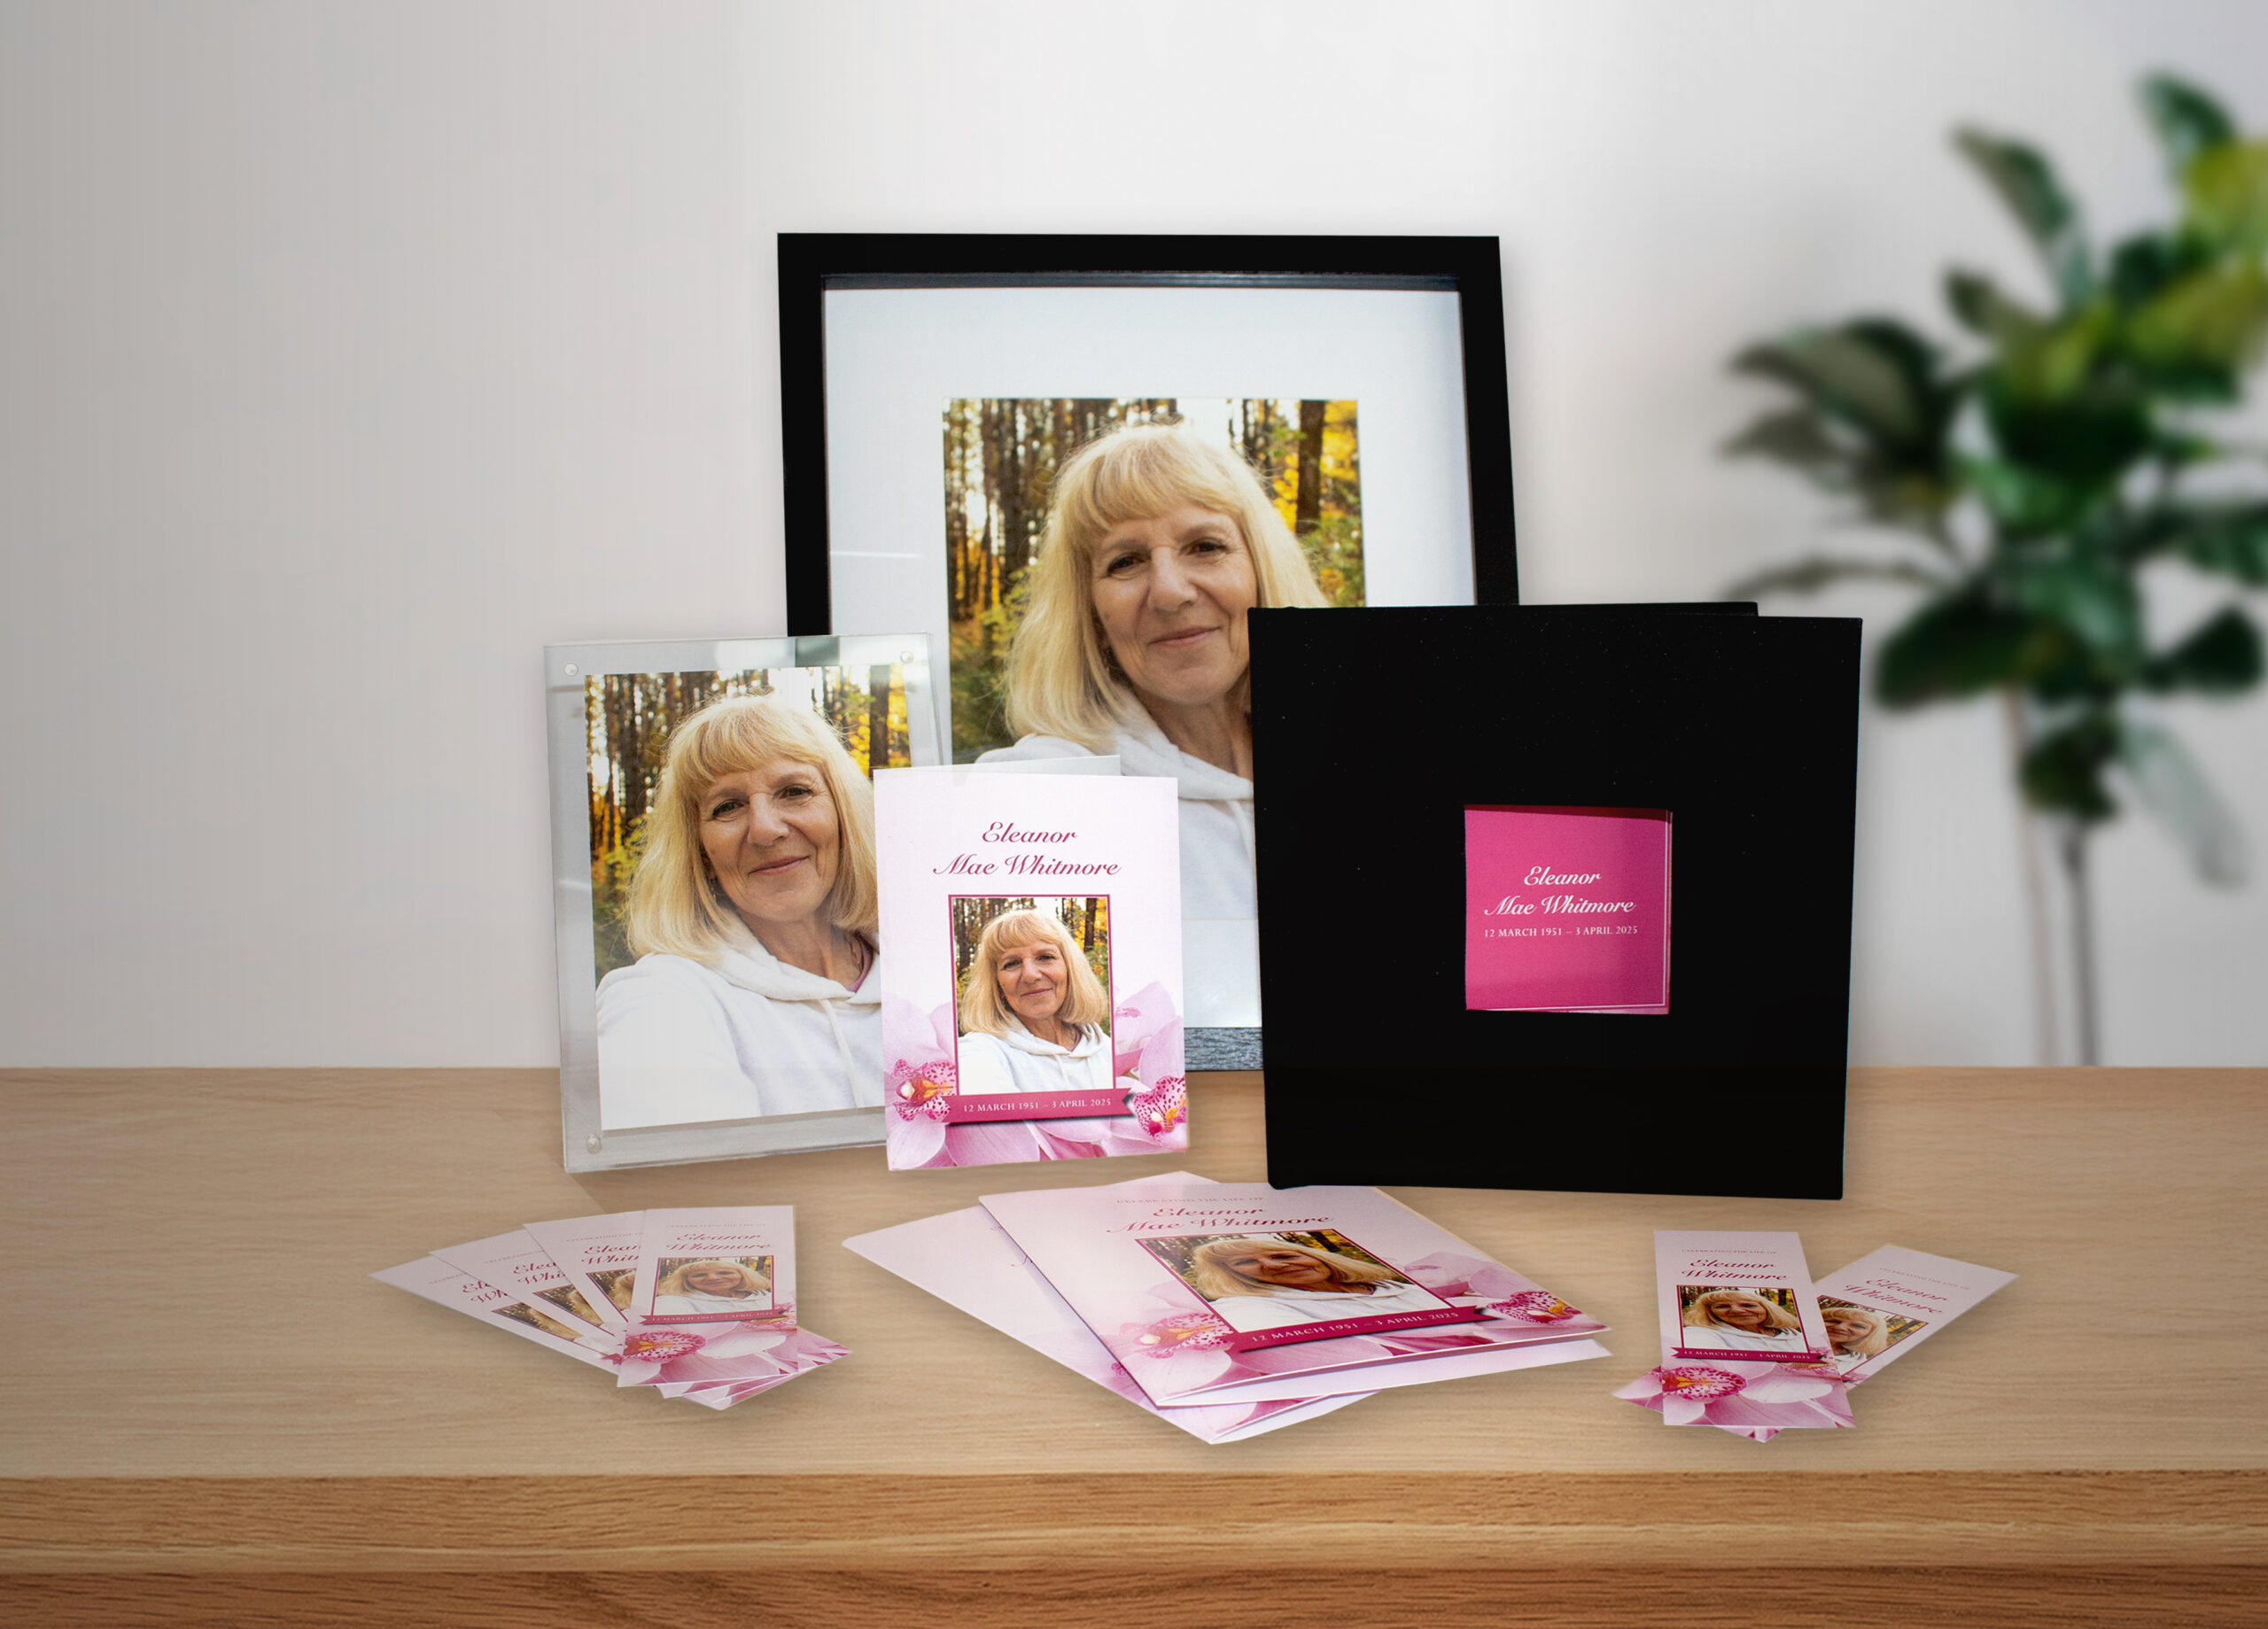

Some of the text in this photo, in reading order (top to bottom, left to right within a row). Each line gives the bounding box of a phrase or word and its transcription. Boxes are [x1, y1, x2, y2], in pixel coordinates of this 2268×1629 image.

[982, 821, 1078, 842] Eleanor
[933, 853, 1121, 875] Mae Whitmore
[1524, 865, 1602, 886] Eleanor
[1484, 895, 1637, 916] Mae Whitmore
[1484, 928, 1495, 938] 12
[1498, 927, 1537, 937] MARCH
[1541, 927, 1562, 936] 1951
[1575, 927, 1581, 935] 3
[1583, 926, 1612, 935] APRIL
[1615, 926, 1638, 935] 2025
[977, 1103, 1015, 1113] MARCH
[1056, 1098, 1088, 1108] APRIL
[1091, 1098, 1112, 1106] 2025
[1153, 1206, 1266, 1217] Eleanor
[1107, 1214, 1334, 1233] Mae Whitmore
[1689, 1259, 1775, 1268] Eleanor
[1682, 1269, 1790, 1280] Whitmore
[1844, 1284, 1943, 1314] Whitmore
[1866, 1278, 1948, 1301] Eleanor
[1251, 1334, 1268, 1343] 12
[1270, 1326, 1325, 1339] MARCH
[1329, 1322, 1358, 1331] 1951
[1385, 1315, 1426, 1325] APRIL
[1429, 1312, 1459, 1321] 2025
